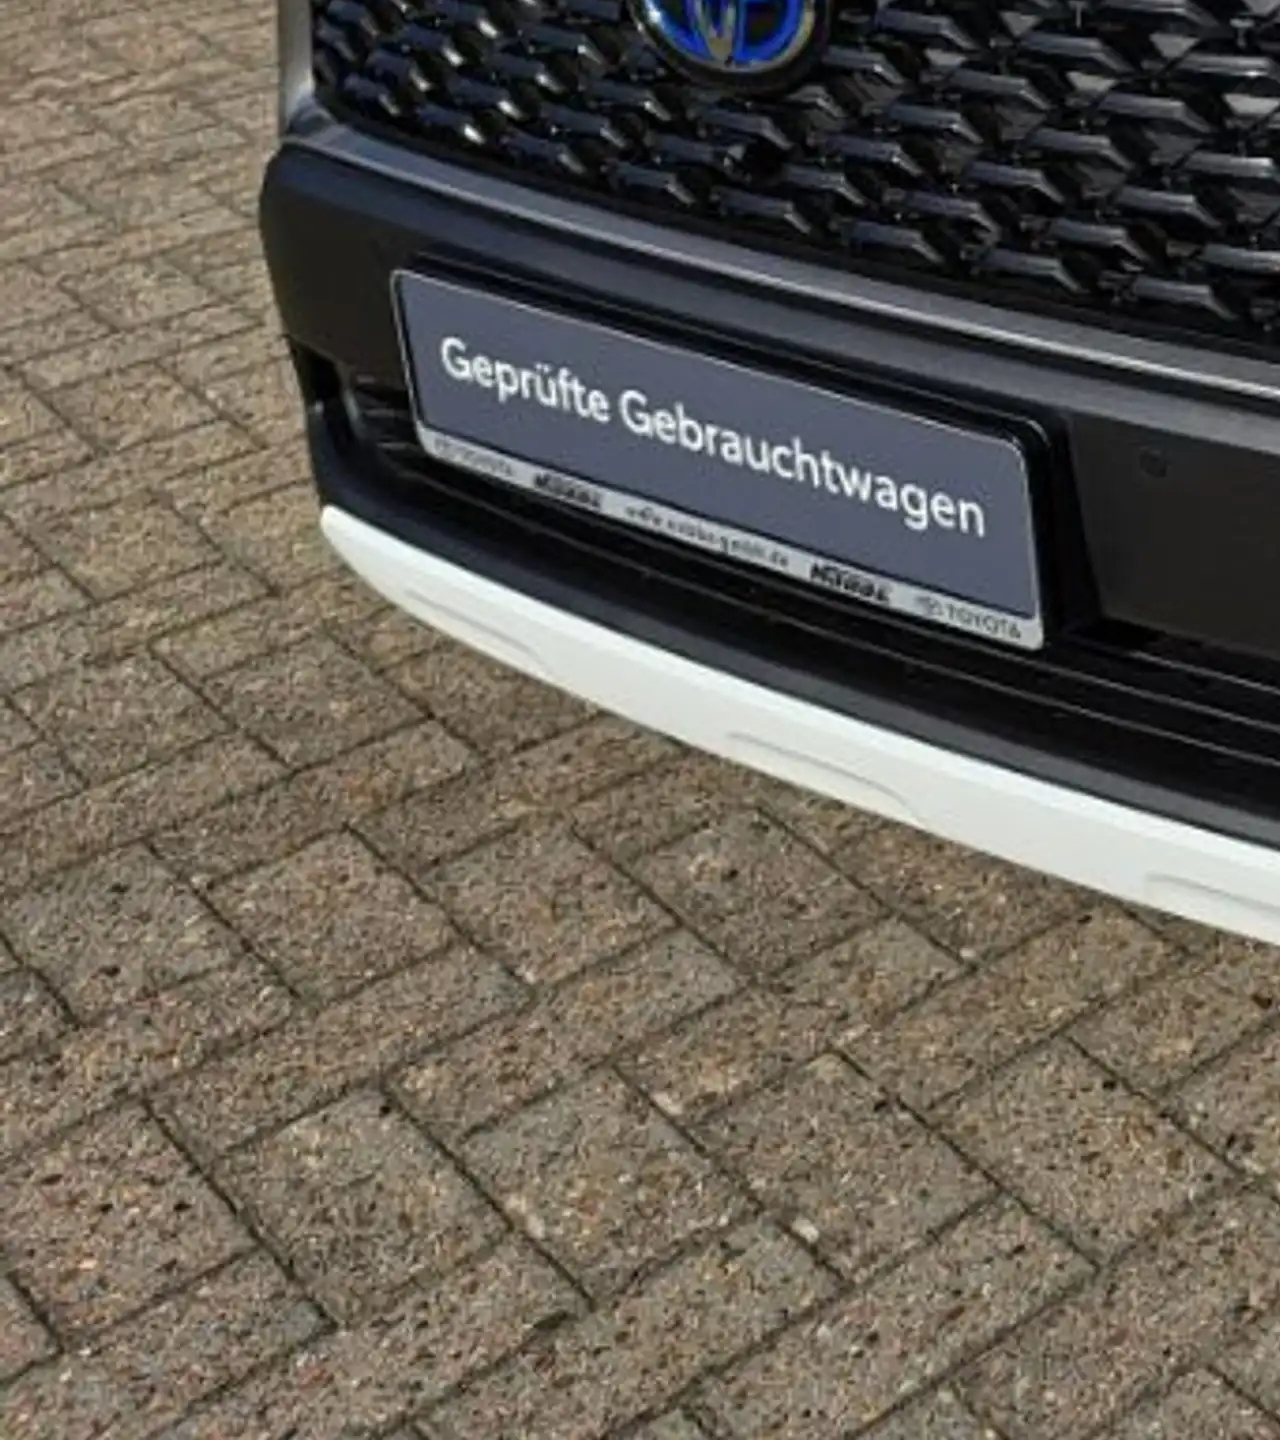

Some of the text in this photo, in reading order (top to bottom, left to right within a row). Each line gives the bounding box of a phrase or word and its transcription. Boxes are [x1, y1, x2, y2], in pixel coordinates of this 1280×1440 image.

[440, 337, 611, 424] Geprüfte
[619, 390, 986, 538] Gebrauchtwagen
[947, 602, 1022, 640] TOYOTA
